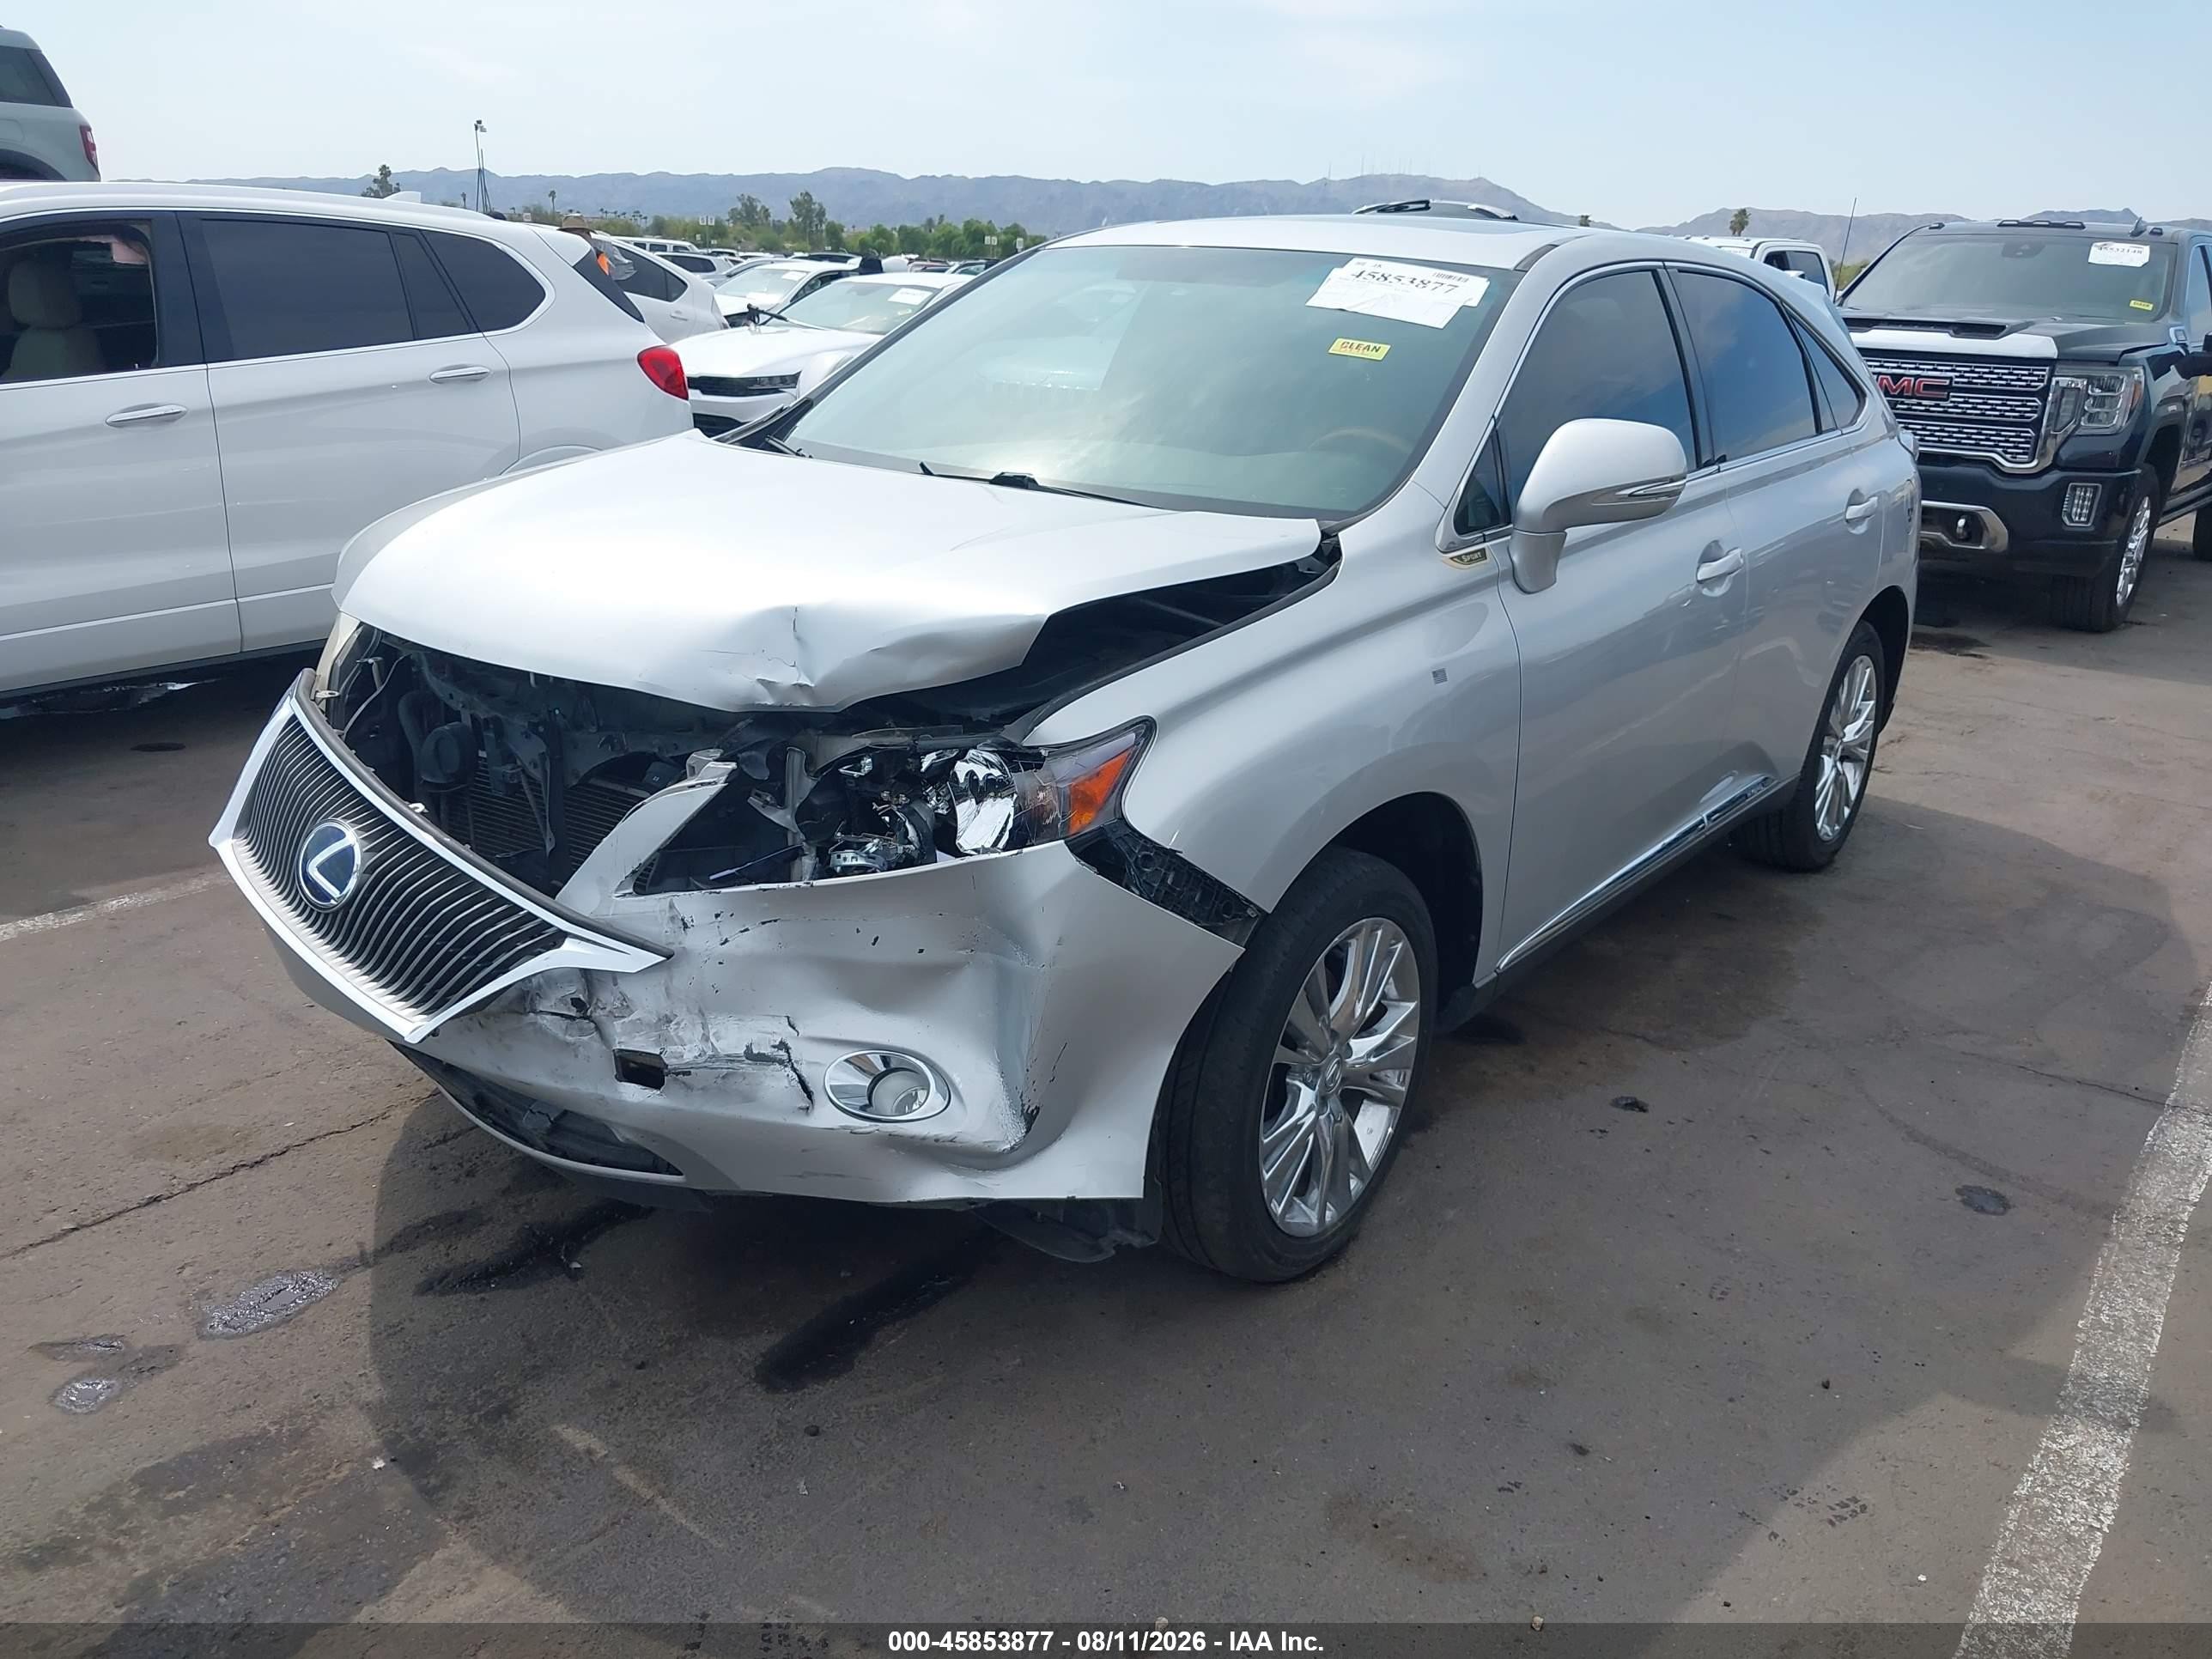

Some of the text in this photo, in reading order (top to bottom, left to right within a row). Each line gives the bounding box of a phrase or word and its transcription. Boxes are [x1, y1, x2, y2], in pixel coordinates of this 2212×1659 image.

[1351, 270, 1460, 294] 45853877
[1340, 341, 1382, 353] CLEAN
[1877, 374, 1950, 398] MC
